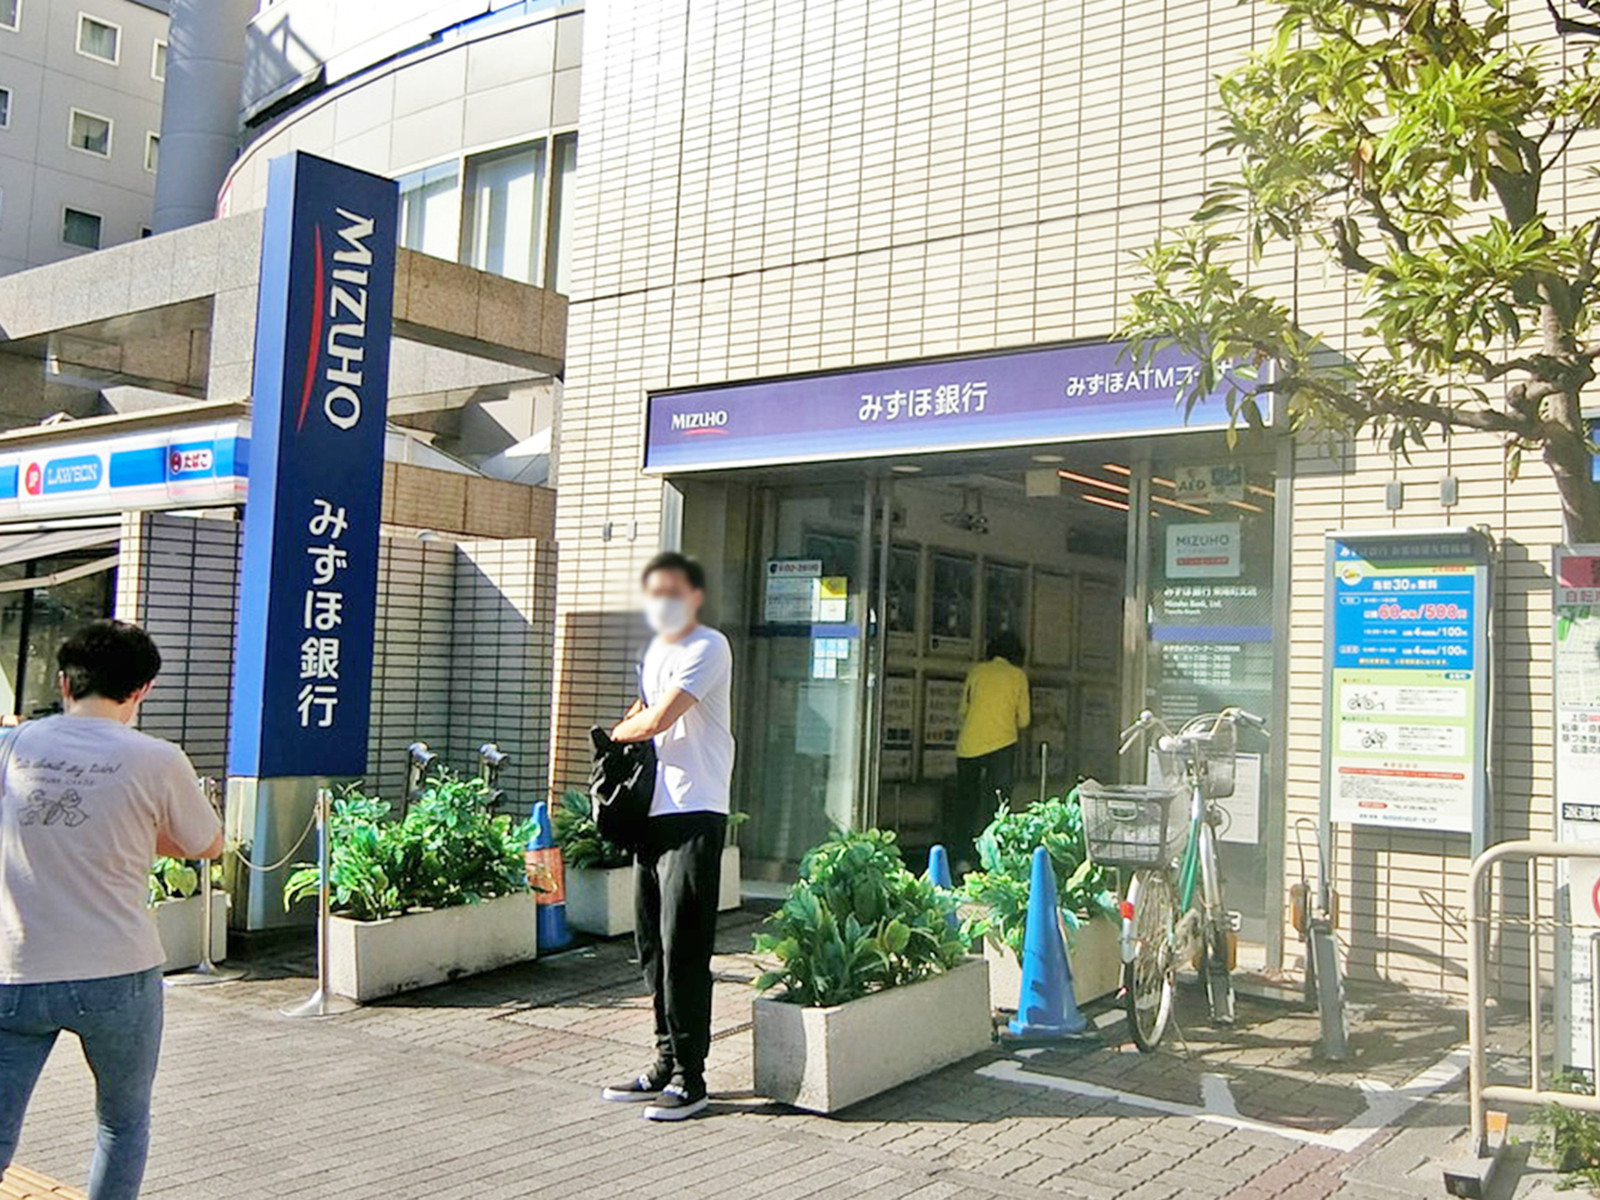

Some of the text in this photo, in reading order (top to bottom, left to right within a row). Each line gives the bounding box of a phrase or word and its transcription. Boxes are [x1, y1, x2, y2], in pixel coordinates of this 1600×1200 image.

[324, 207, 376, 431] MIZUHO
[858, 381, 988, 421] みずほ銀行
[670, 409, 728, 430] MIZUHO
[184, 453, 208, 469] たばこ
[47, 464, 98, 485] LAWSON
[1178, 480, 1206, 491] AED
[1175, 534, 1229, 547] MIZUHO
[1566, 590, 1600, 603] 自転
[297, 498, 349, 728] みずほ銀行
